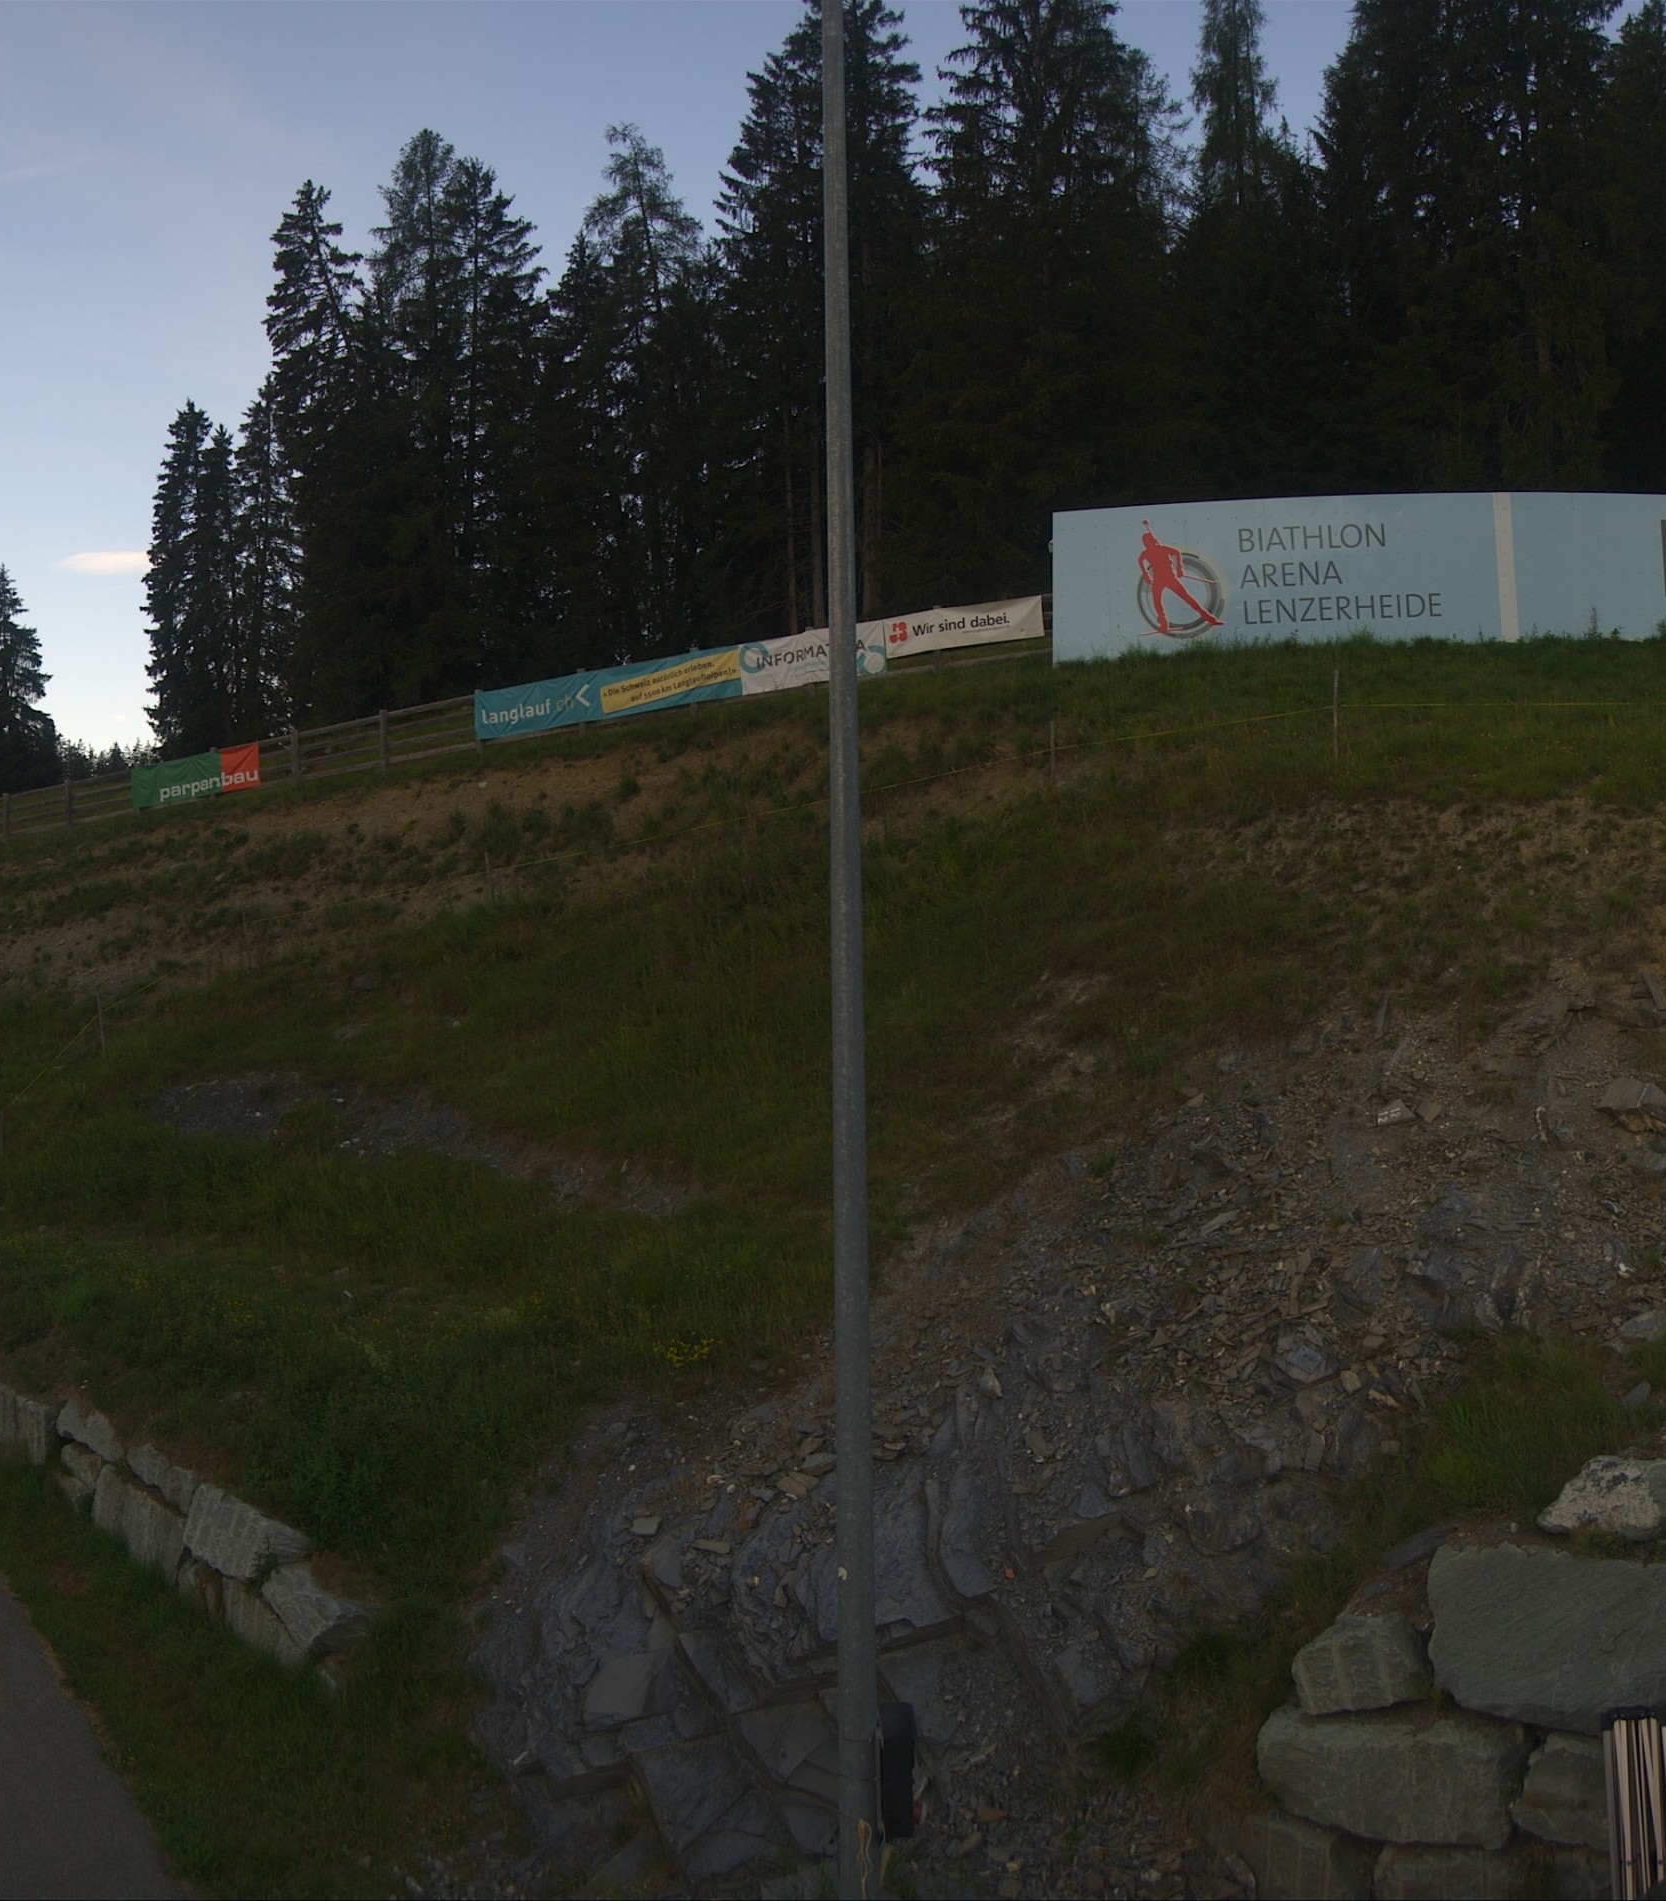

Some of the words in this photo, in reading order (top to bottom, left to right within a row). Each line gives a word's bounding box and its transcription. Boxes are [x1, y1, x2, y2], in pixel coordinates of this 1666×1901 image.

[1237, 522, 1387, 553] BIATHLON
[1240, 560, 1343, 589] ARENA
[1242, 592, 1443, 625] LENZERHEIDE
[912, 621, 934, 637] Wir
[938, 617, 965, 634] sind
[970, 612, 1010, 629] dabei.
[621, 679, 652, 695] Schweiz
[652, 669, 683, 688] natürlich
[631, 693, 643, 703] auf
[661, 687, 673, 698] km
[160, 769, 259, 802] parpanbau
